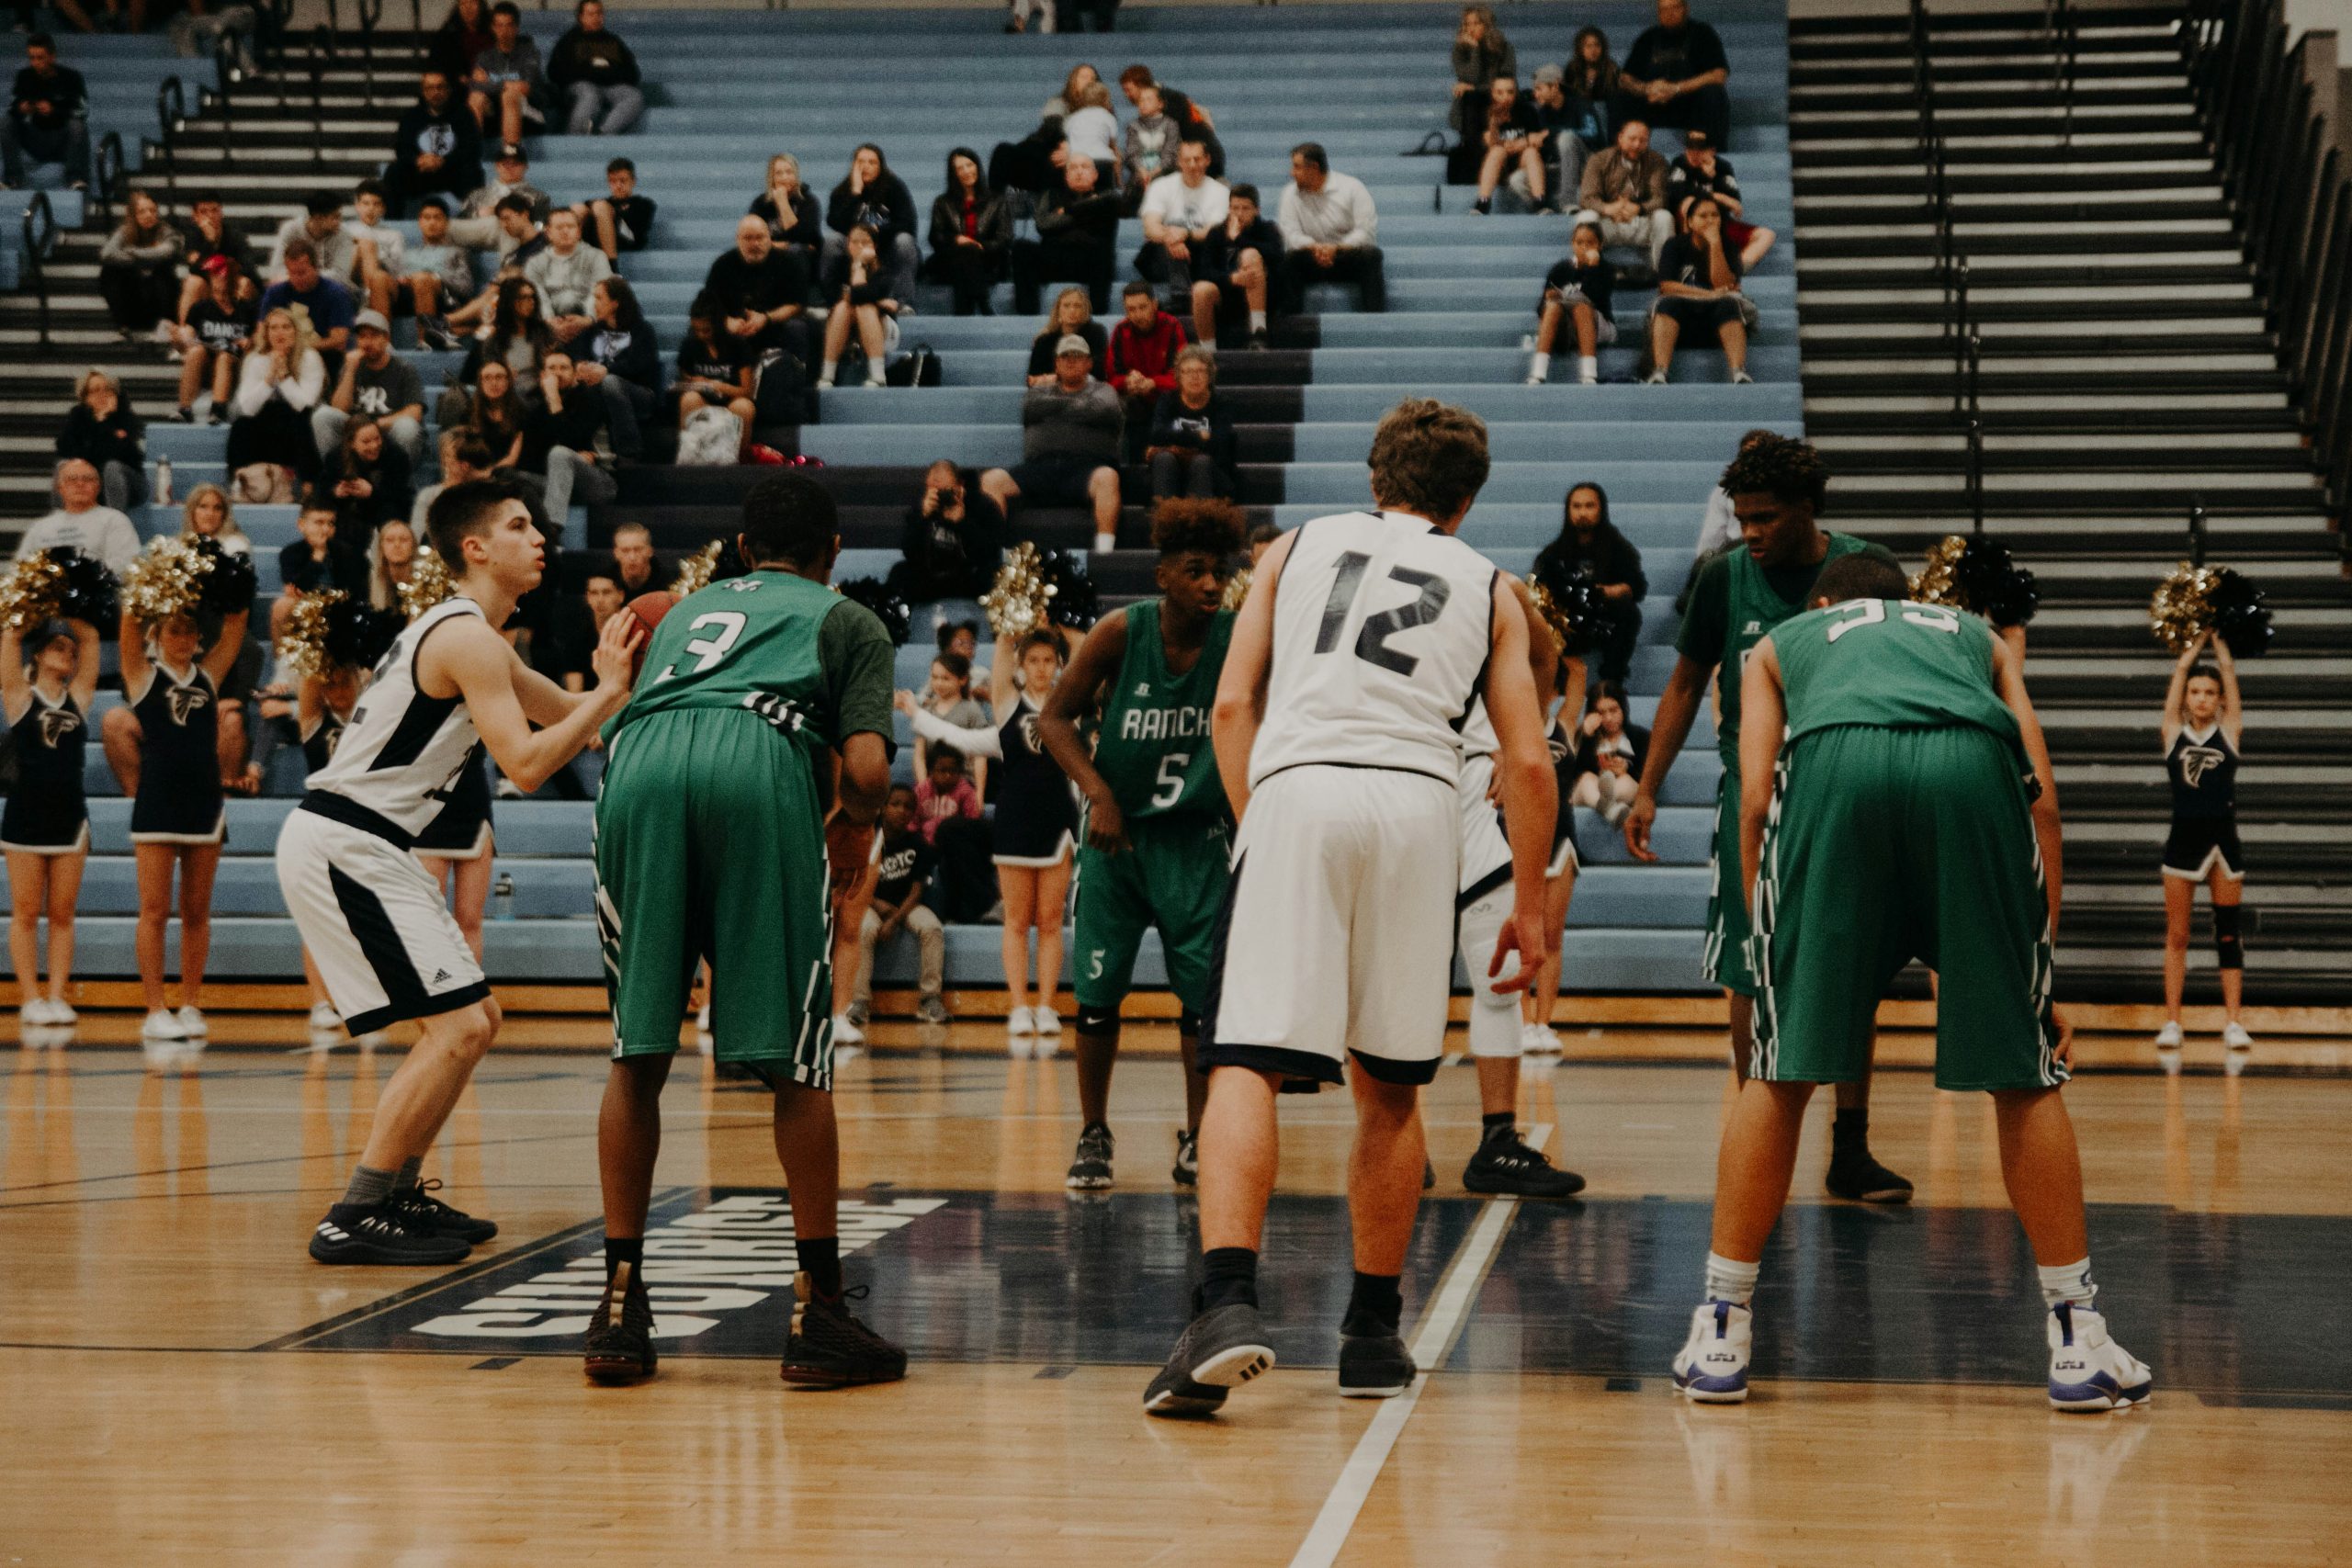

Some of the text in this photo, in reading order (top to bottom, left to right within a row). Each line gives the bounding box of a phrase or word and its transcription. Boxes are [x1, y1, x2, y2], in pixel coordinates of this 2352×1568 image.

[1314, 549, 1451, 678] 12
[1150, 752, 1191, 808] 5
[1086, 948, 1106, 981] 5
